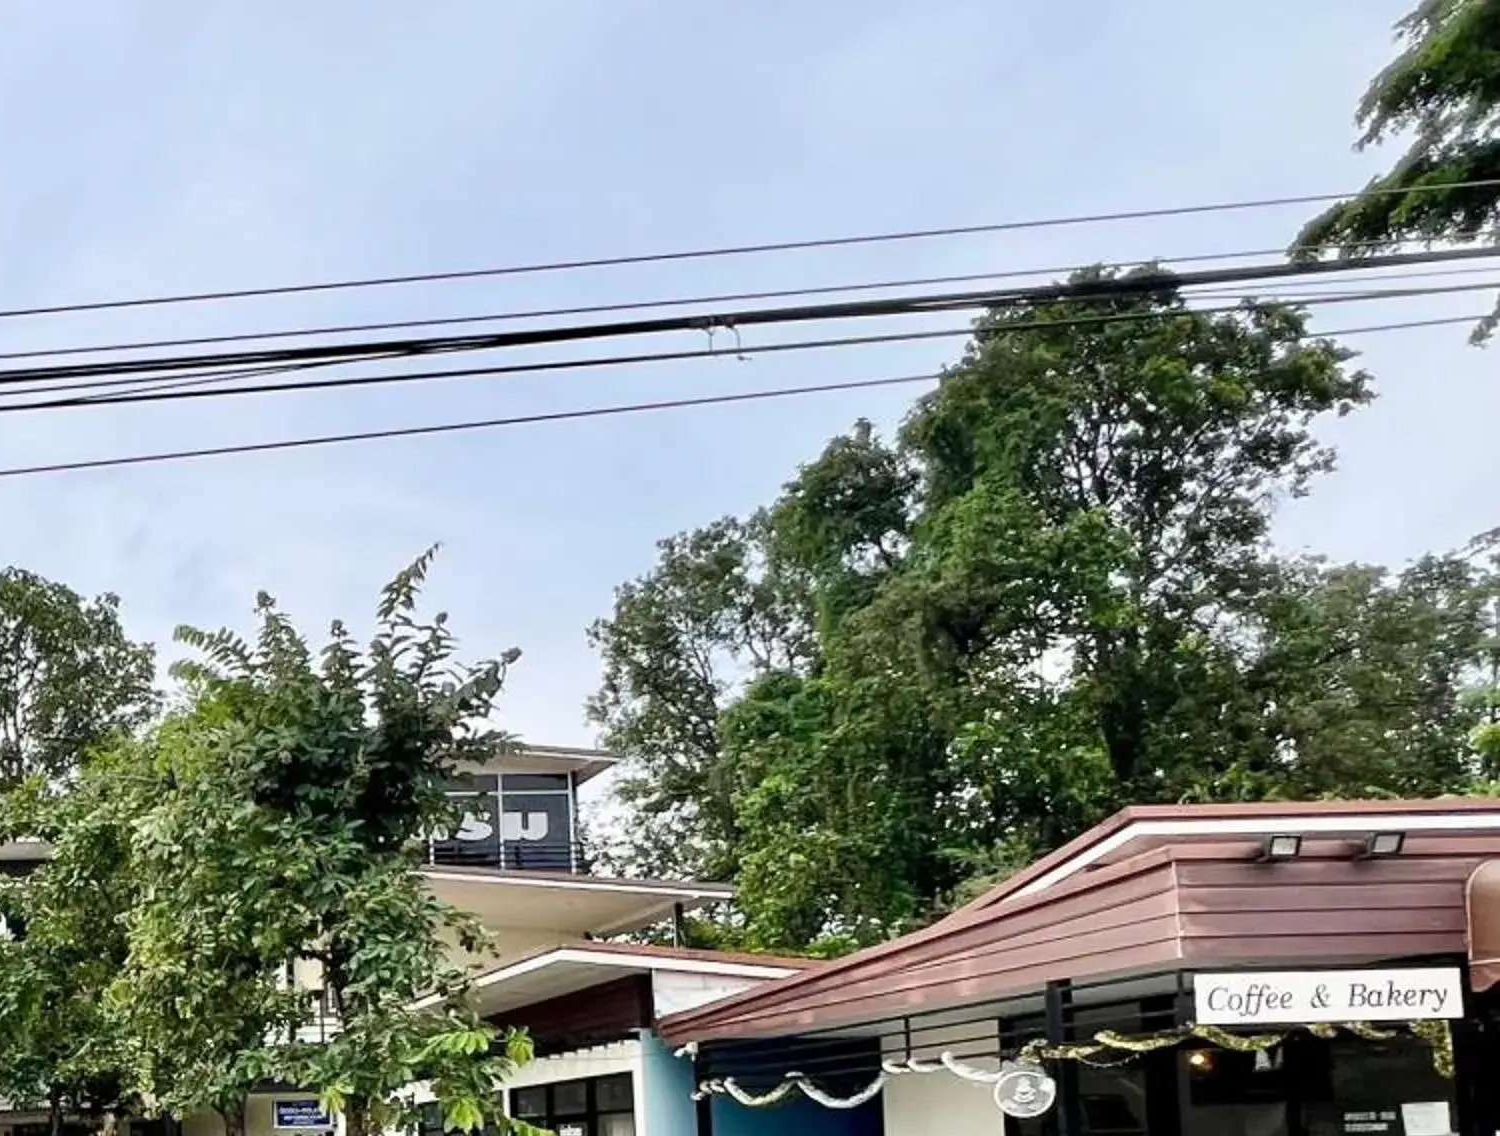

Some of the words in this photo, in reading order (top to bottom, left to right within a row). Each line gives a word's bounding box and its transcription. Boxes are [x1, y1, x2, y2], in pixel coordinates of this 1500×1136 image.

[1207, 983, 1293, 1017] Coffee
[1310, 983, 1331, 1009] &
[1348, 980, 1448, 1013] Bakery
